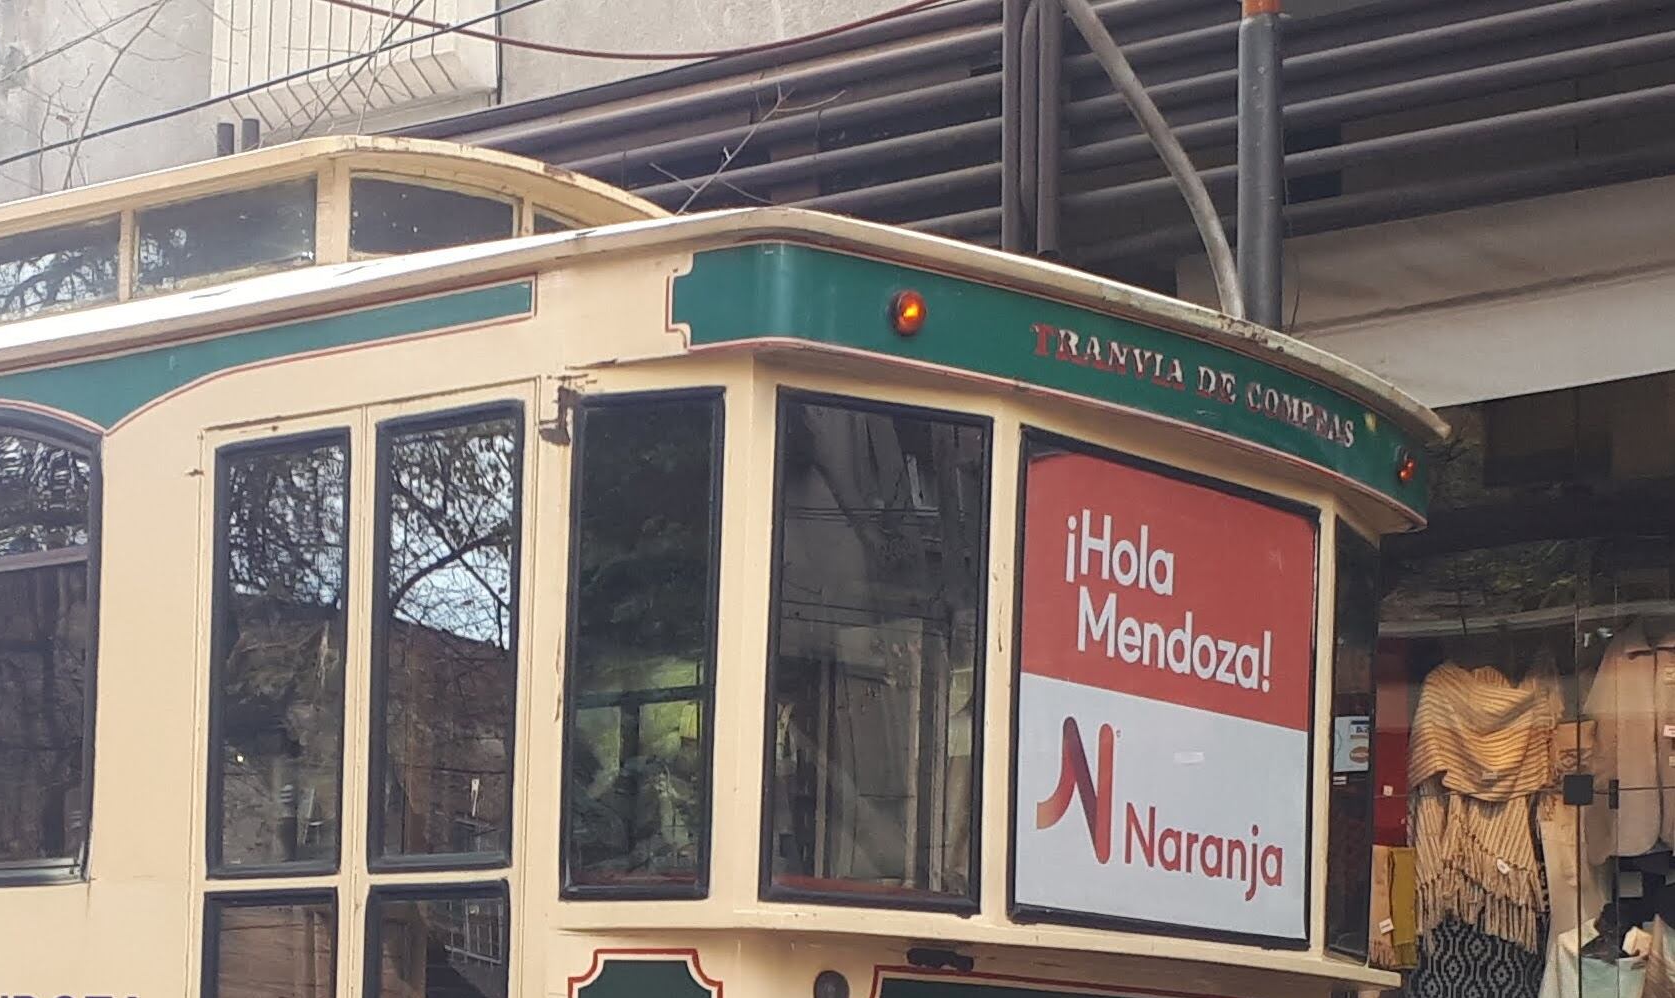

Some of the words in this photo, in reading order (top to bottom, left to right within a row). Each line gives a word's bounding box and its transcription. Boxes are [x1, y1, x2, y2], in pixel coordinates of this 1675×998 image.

[1030, 322, 1185, 390] TRANVIA
[1196, 364, 1238, 404] DE
[1065, 508, 1174, 596] ¡Hola
[1077, 585, 1272, 693] Mendoza!
[1124, 801, 1283, 901] Naranja
